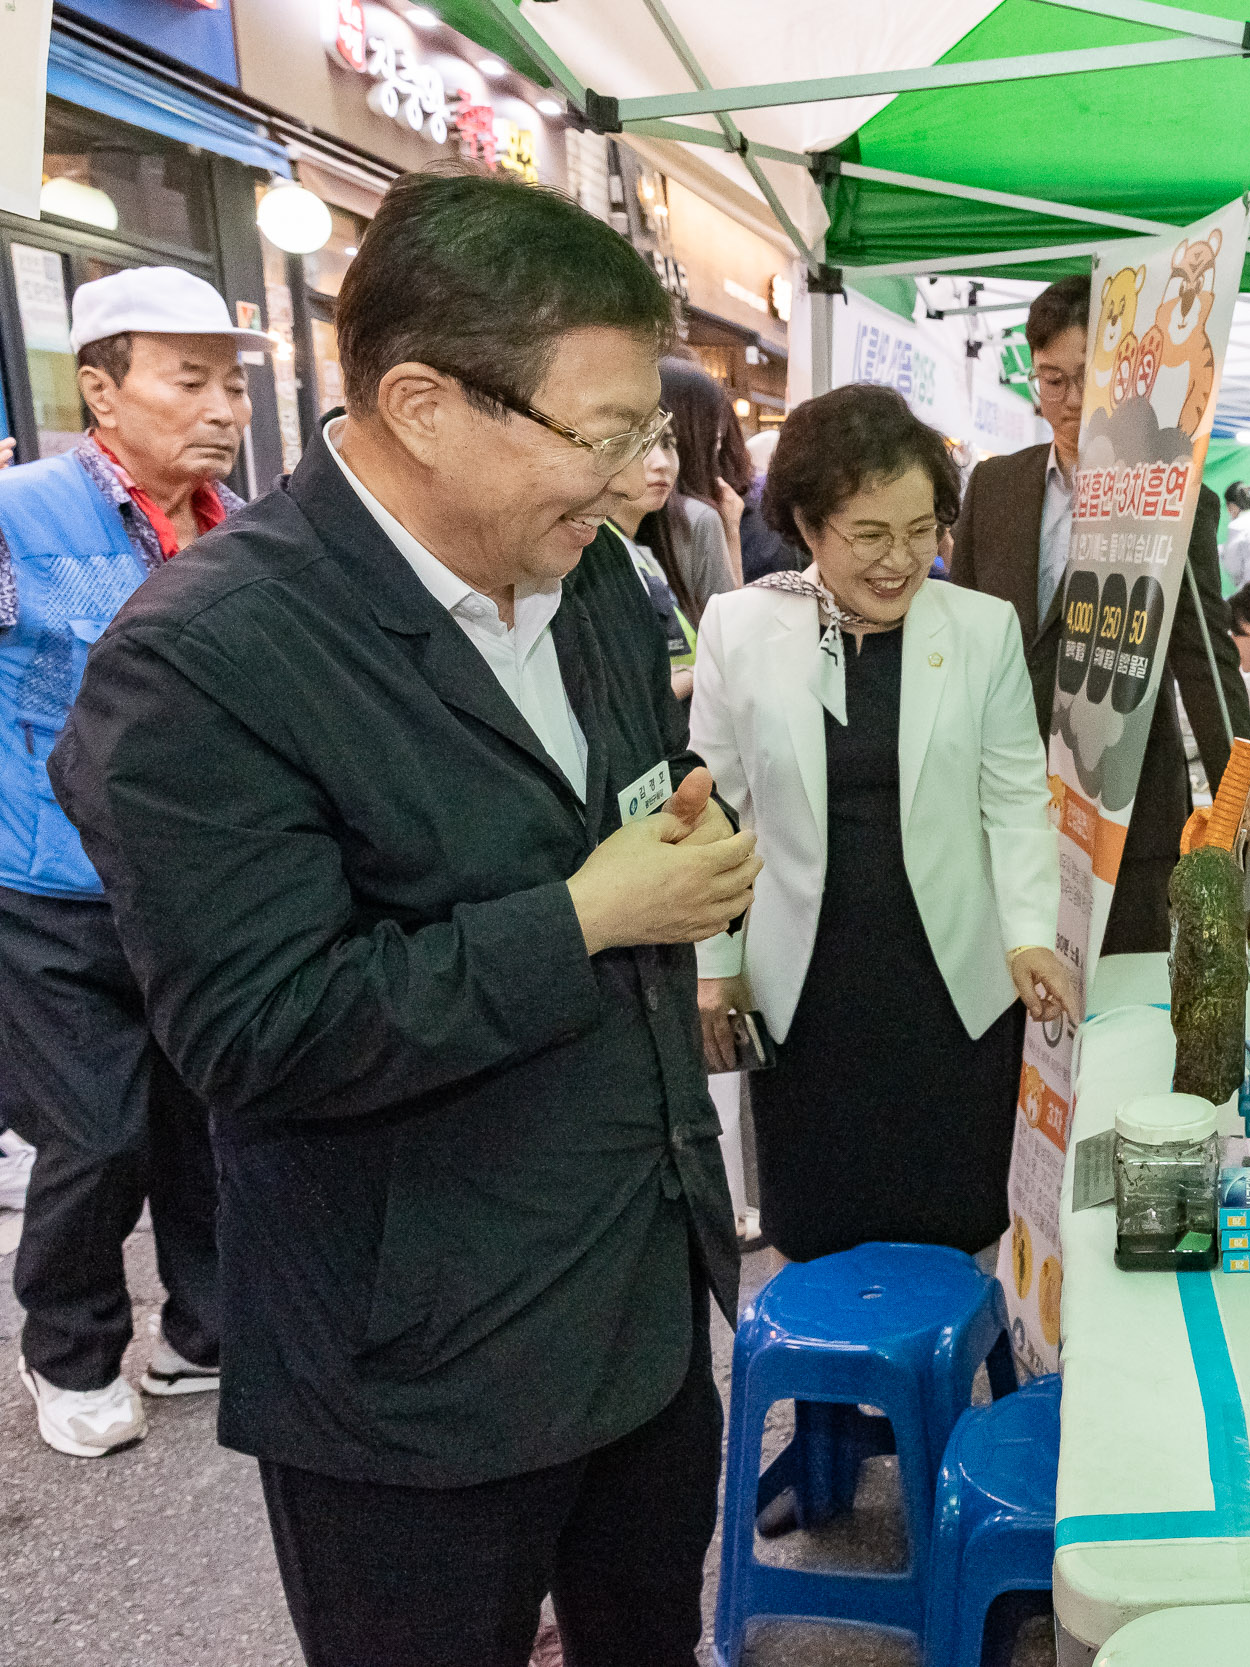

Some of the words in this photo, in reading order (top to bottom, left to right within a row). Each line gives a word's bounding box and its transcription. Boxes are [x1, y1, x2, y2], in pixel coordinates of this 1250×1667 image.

[1066, 601, 1094, 635] 4,000
[1101, 605, 1122, 640] 250
[1128, 610, 1148, 645] 50
[1128, 654, 1149, 679] 물질
